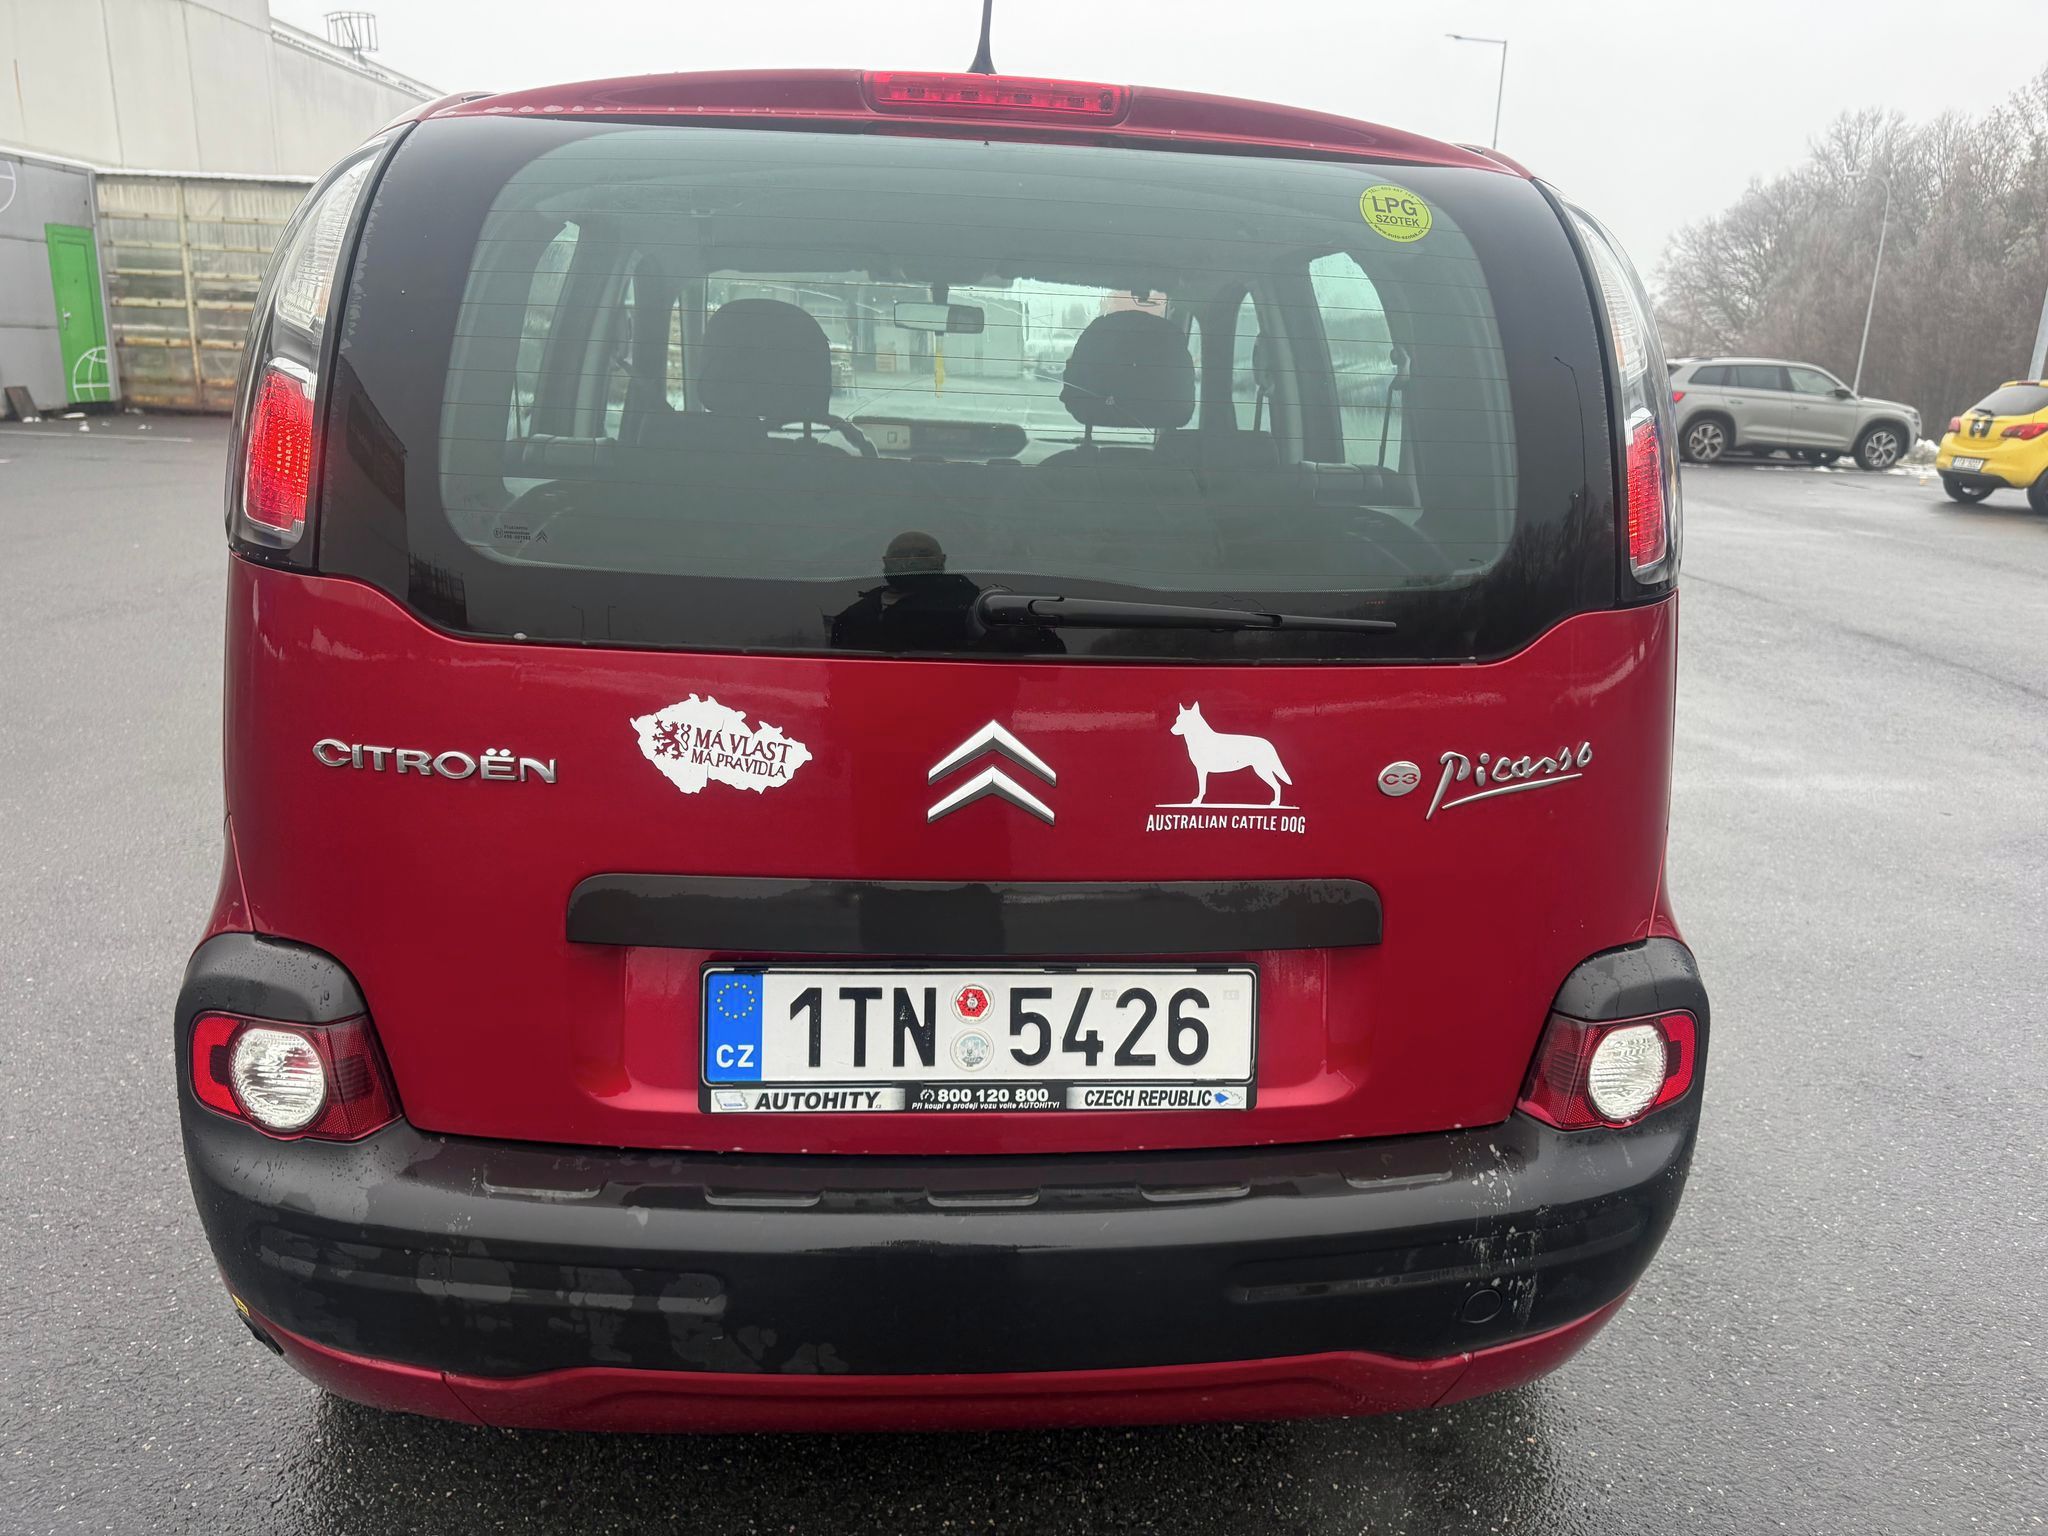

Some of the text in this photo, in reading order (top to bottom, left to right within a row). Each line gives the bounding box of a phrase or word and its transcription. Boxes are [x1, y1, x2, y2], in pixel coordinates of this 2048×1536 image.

[1371, 195, 1418, 217] LPG
[1375, 214, 1420, 228] SZOTEK
[694, 727, 793, 764] MÁ VLAST
[312, 738, 556, 784] CITROËN
[691, 748, 787, 779] MÁ PRAVIDLA
[1425, 741, 1593, 820] Picasso
[1146, 814, 1306, 834] AUSTRALIAN CATTLE DOG
[789, 986, 1211, 1068] 1TN 5426
[716, 1043, 755, 1068] CZ
[937, 1088, 1049, 1102] 800 120 800
[1084, 1090, 1212, 1107] CZECH REPUBLIC
